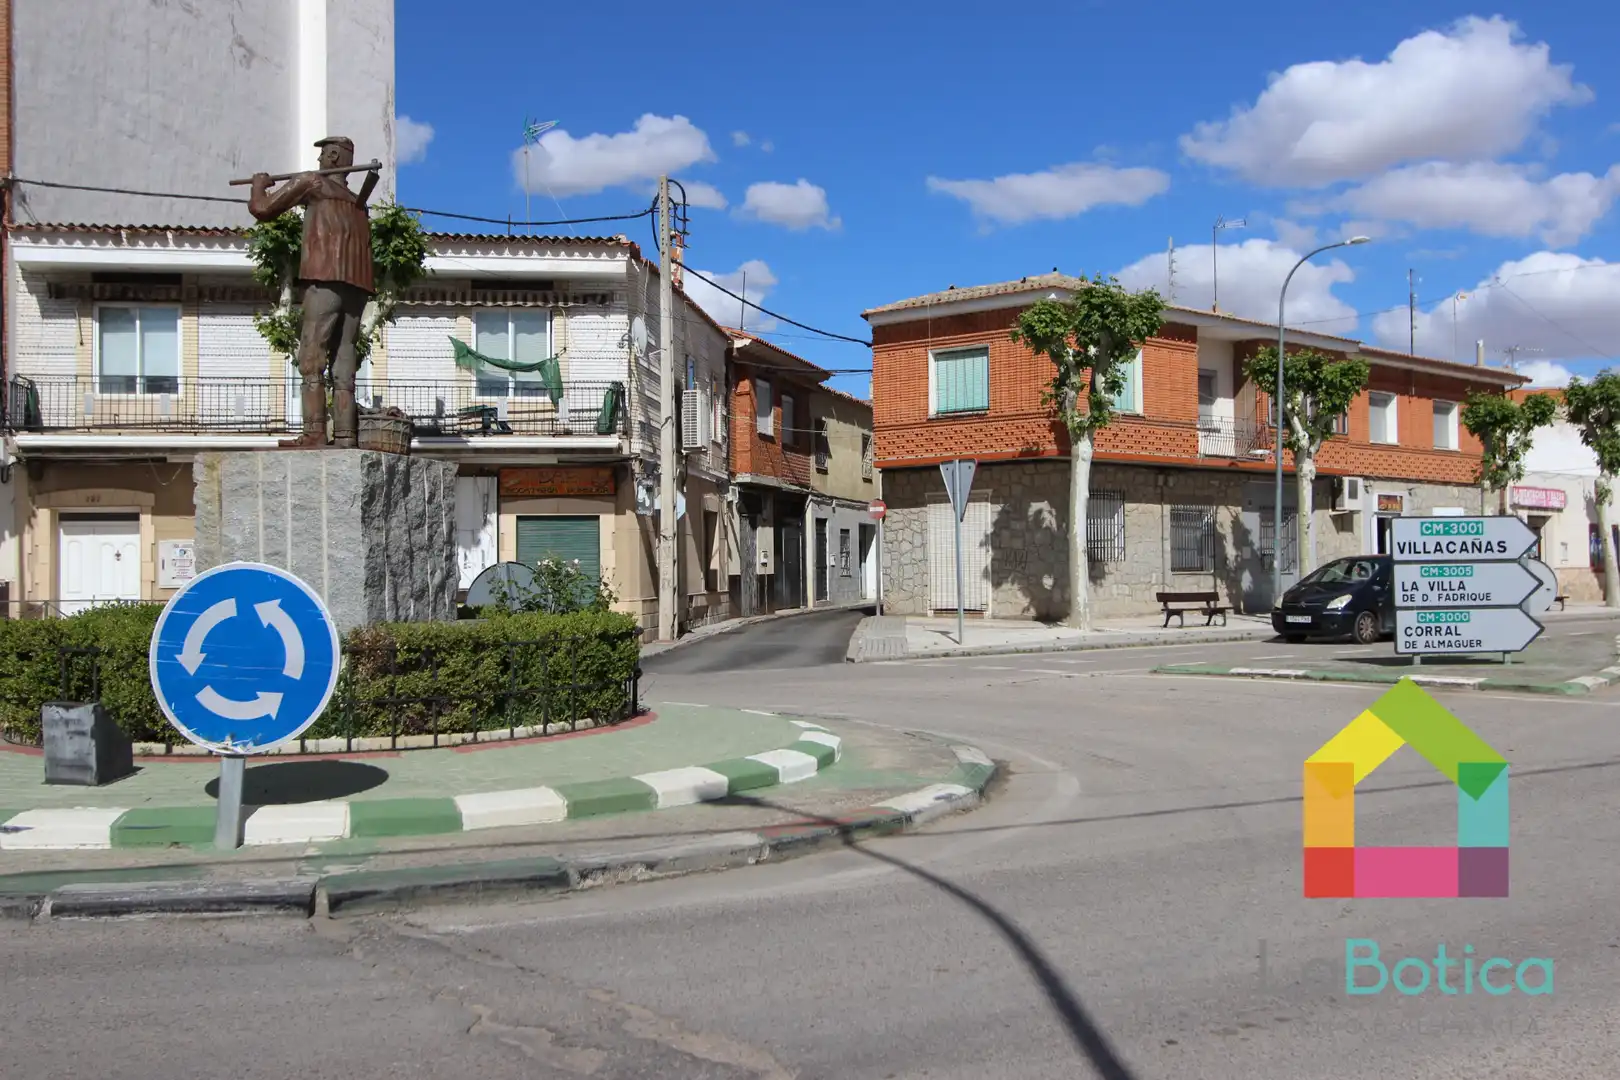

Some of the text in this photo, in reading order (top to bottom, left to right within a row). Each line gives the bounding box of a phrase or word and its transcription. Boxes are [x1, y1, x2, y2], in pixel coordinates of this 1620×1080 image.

[1421, 522, 1483, 535] CM-3001
[1397, 538, 1507, 554] VILLACAÑAS
[1421, 566, 1472, 576] CM-3005
[1401, 581, 1466, 592] LA VILLA
[1402, 593, 1492, 602] DE D. FADRIQUE
[1417, 612, 1469, 622] CM-3000
[1404, 626, 1462, 637] CORRAL
[1404, 640, 1482, 649] DE ALMAGUER
